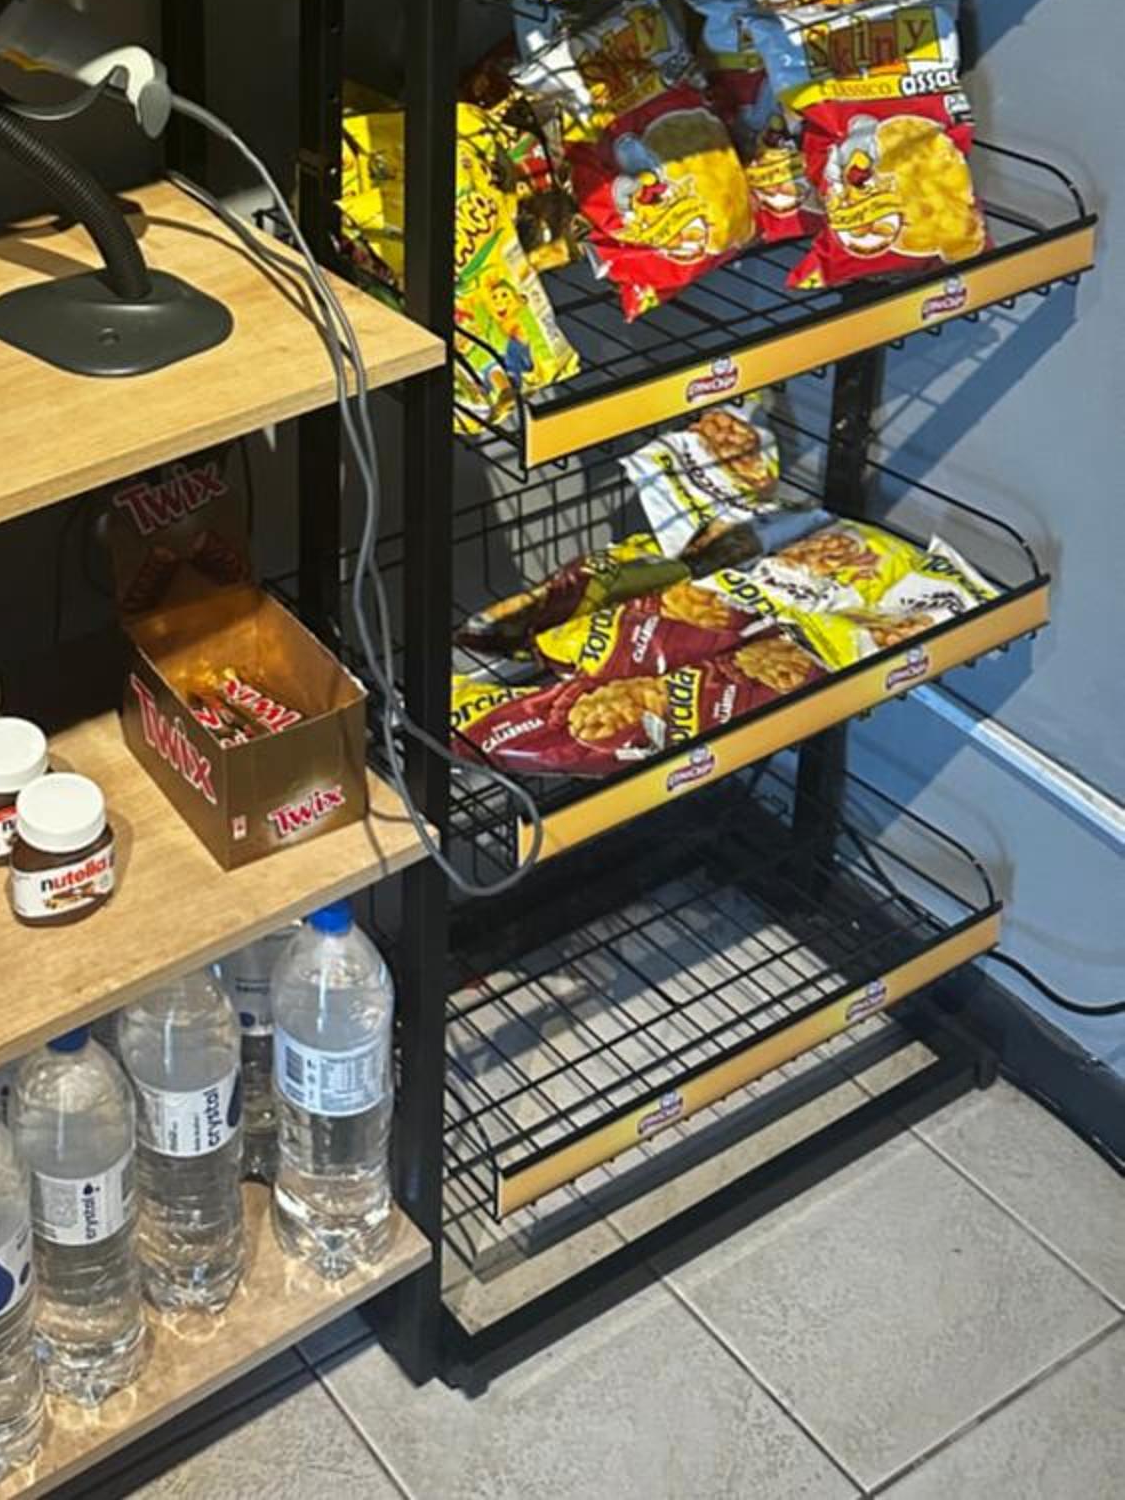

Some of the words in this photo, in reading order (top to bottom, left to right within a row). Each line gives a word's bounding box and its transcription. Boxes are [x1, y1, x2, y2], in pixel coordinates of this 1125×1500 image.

[114, 462, 228, 536] Twix
[130, 673, 218, 805] Twix
[480, 716, 546, 754] CALABRESA
[266, 784, 347, 837] Twix
[40, 857, 107, 893] nutella
[206, 1087, 221, 1148] crystal
